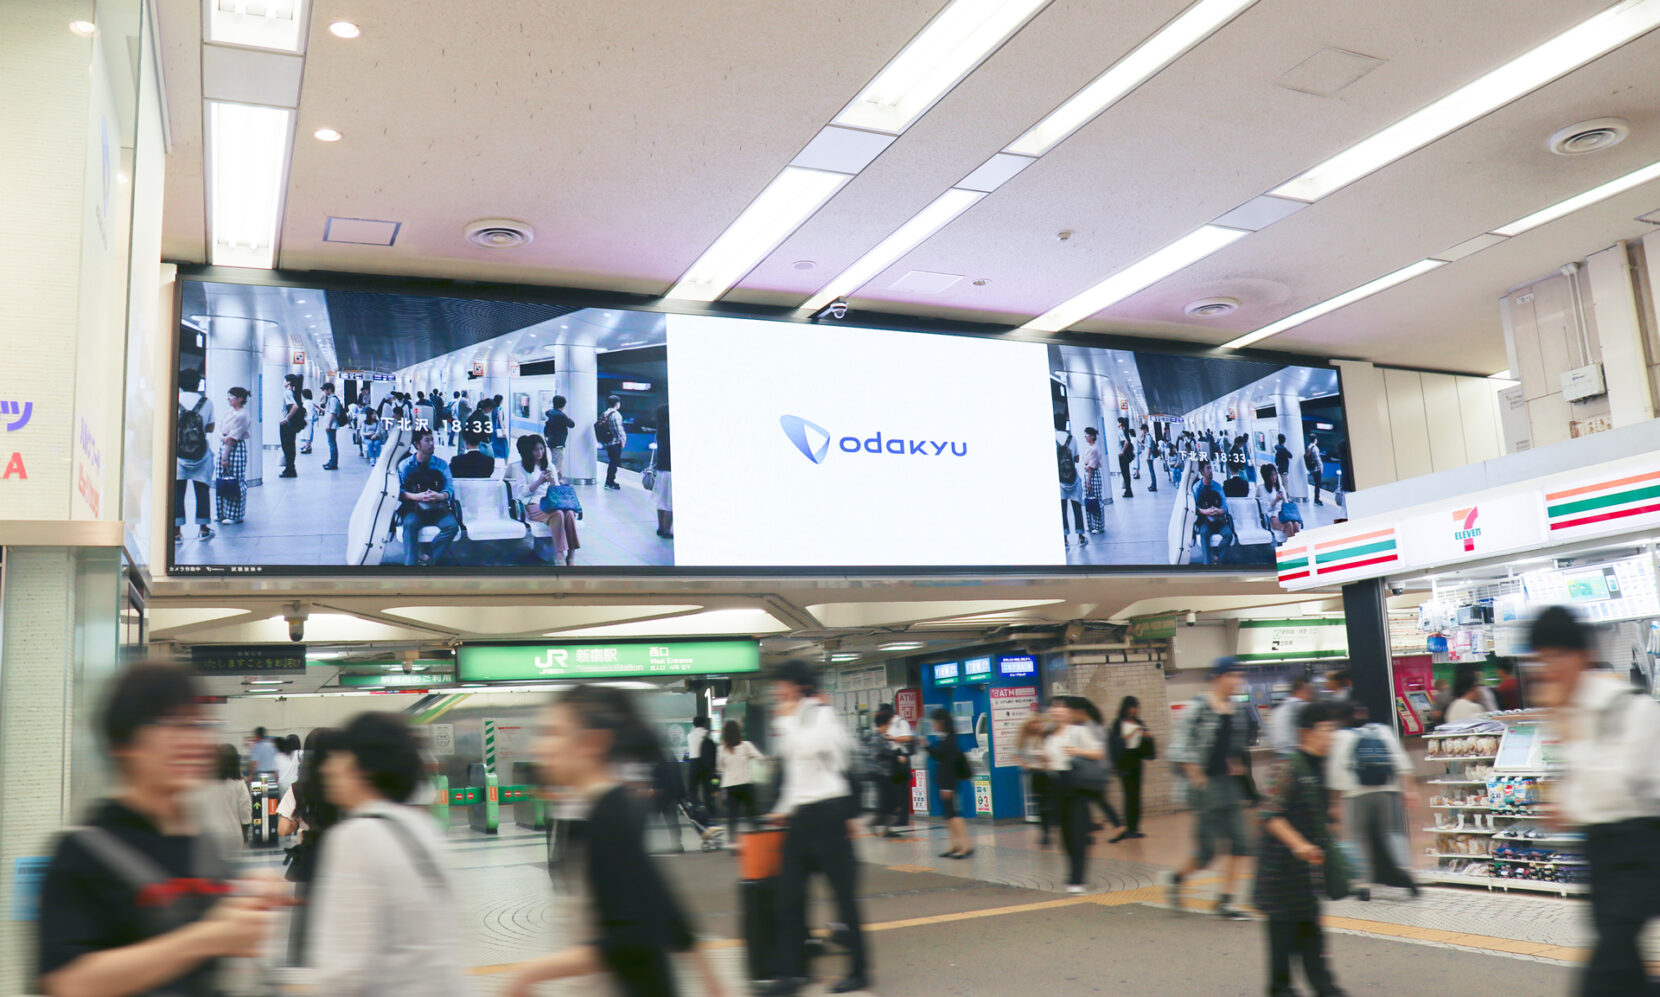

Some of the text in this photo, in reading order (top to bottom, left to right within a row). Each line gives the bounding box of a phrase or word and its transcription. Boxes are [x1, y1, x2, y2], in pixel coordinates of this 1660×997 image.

[381, 417, 494, 433] 下北沢 18:33
[839, 431, 968, 457] odakyu
[1215, 452, 1246, 463] 18:33
[1452, 506, 1479, 552] 7
[534, 648, 569, 668] JR
[1000, 688, 1015, 697] ATM
